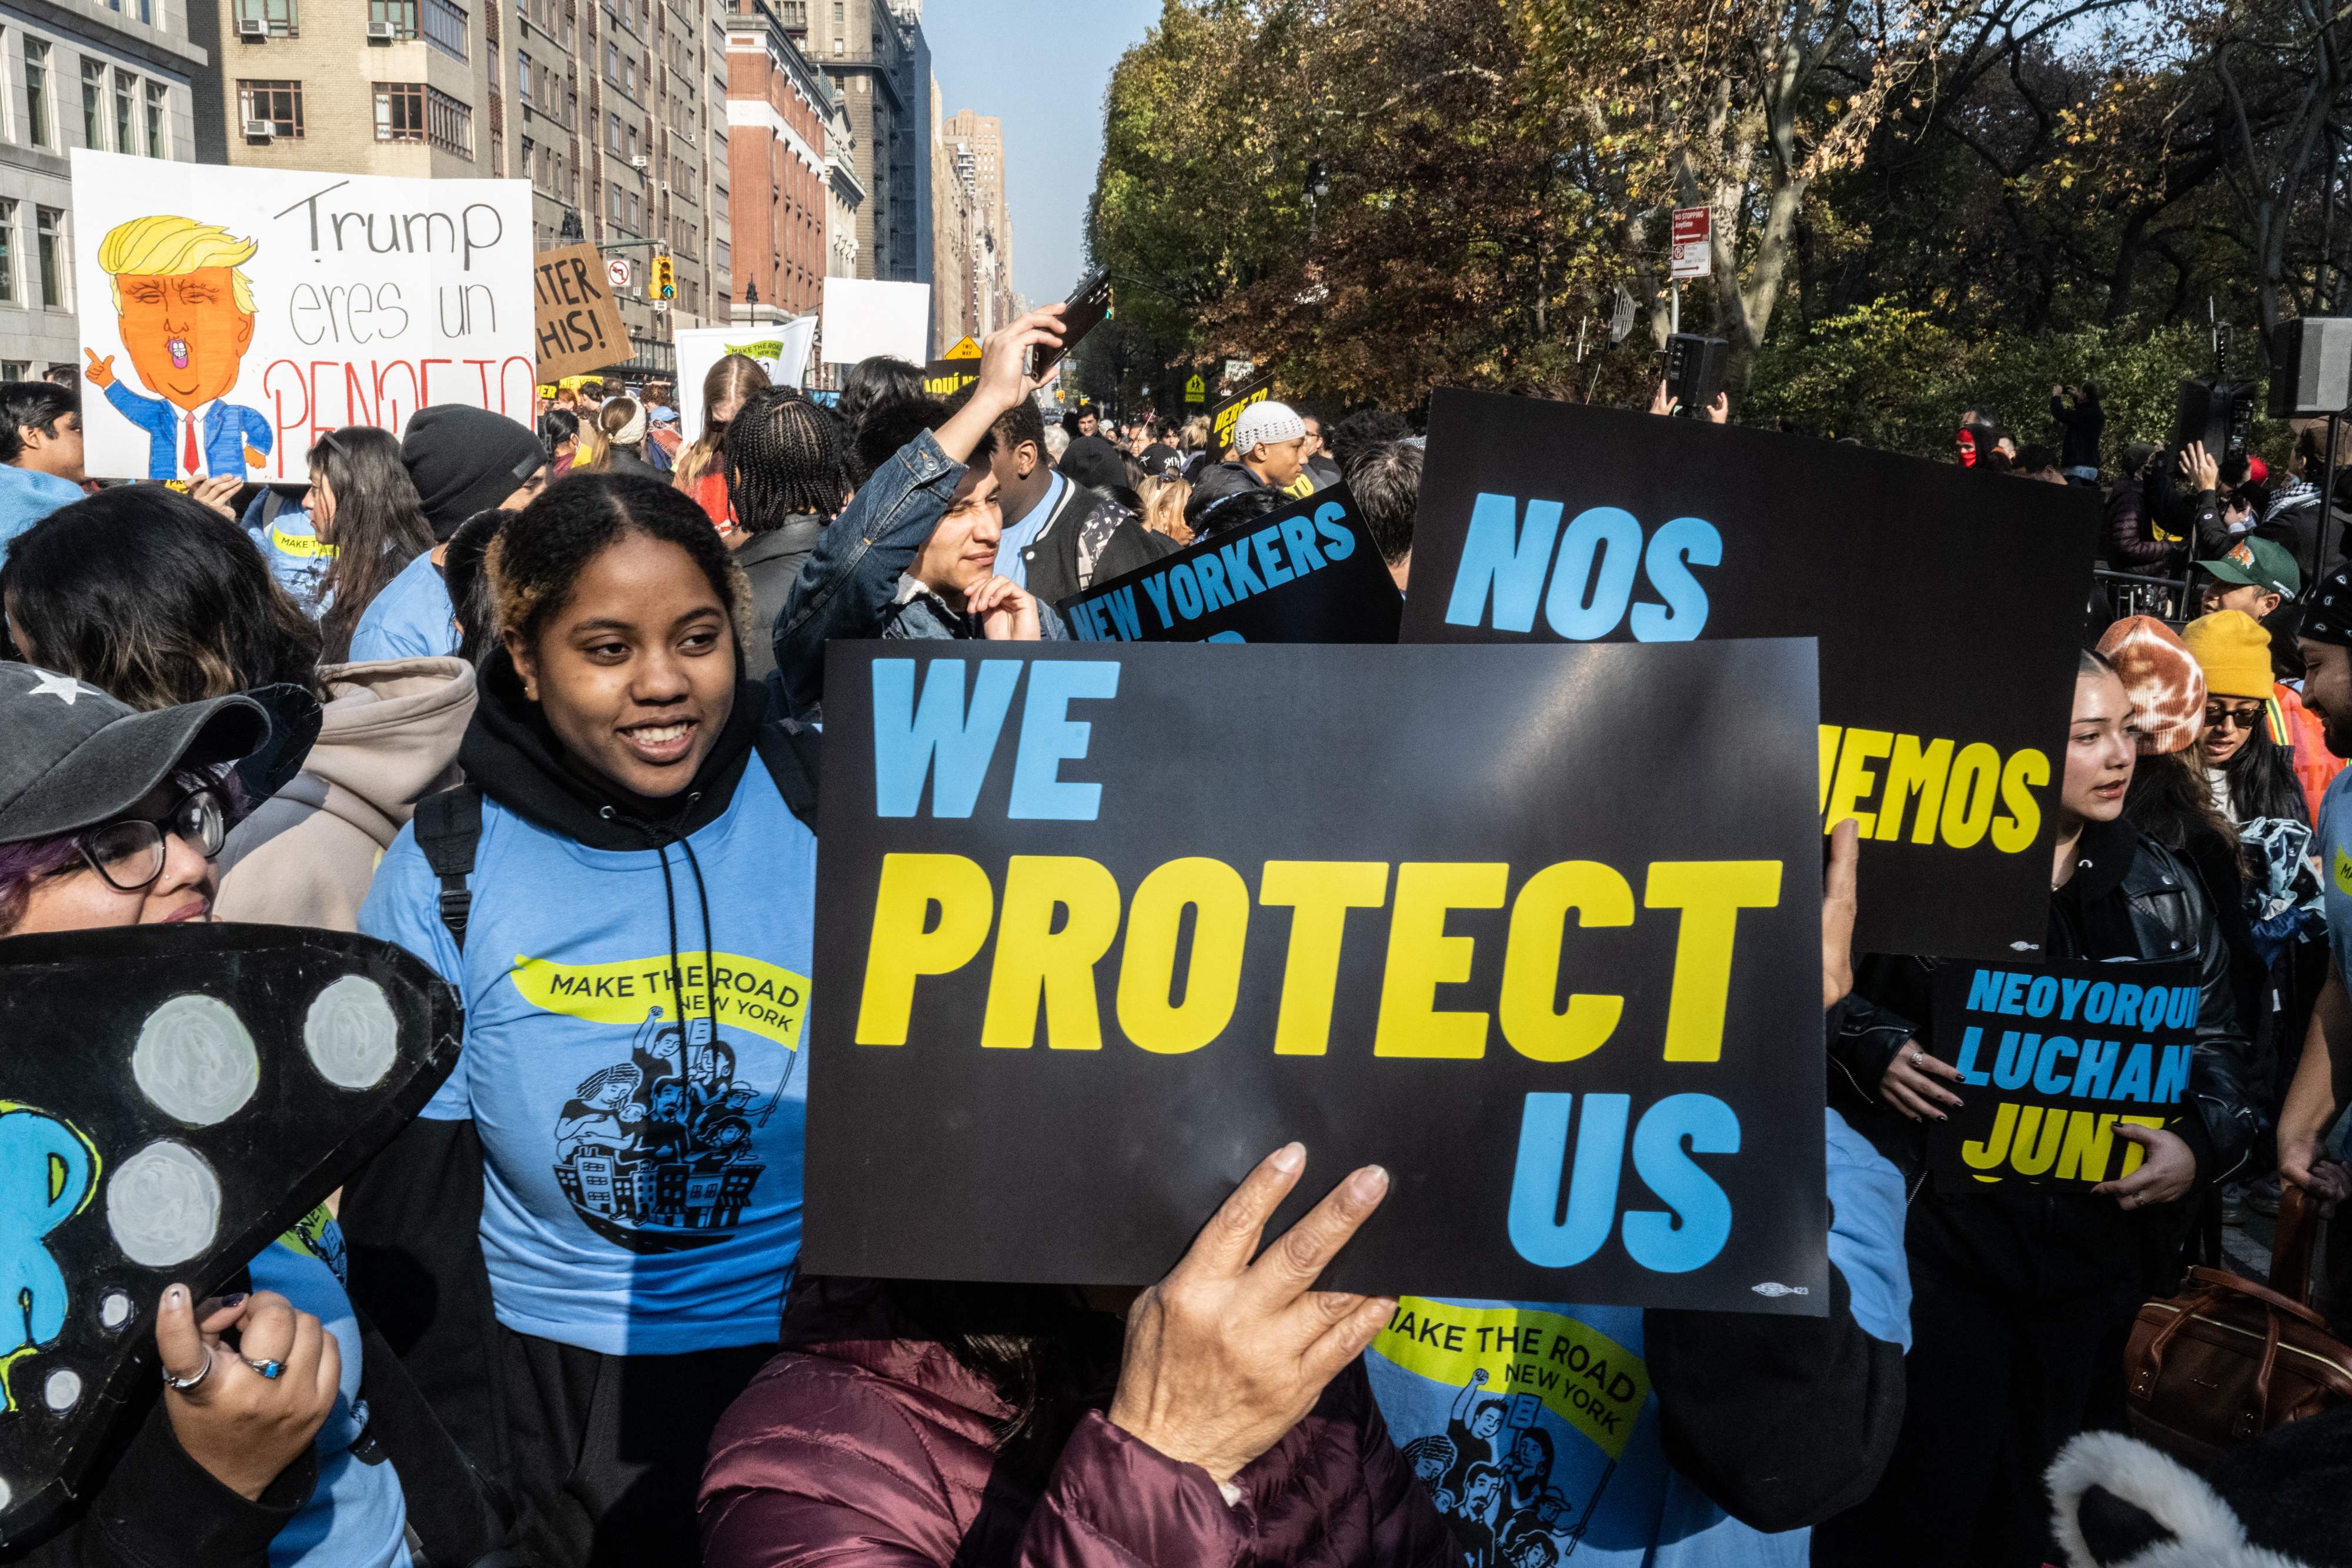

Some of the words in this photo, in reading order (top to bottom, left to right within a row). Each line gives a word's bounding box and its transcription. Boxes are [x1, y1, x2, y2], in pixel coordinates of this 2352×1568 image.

[273, 180, 503, 271] Trump
[1675, 221, 1693, 229] Anytime
[1682, 211, 1703, 219] STOPPING
[290, 283, 408, 345] eres
[440, 284, 496, 338] un
[534, 258, 602, 305] TTER
[768, 343, 782, 351] ROAD
[1214, 397, 1248, 434] HERE
[1251, 387, 1268, 402] TO
[281, 537, 308, 548] MAKE
[1069, 584, 1142, 642] NEW
[1141, 501, 1356, 629] YORKERS
[1445, 492, 1723, 643] NOS
[871, 658, 1121, 820] WE
[550, 974, 634, 998] MAKE
[643, 965, 704, 994] THE
[713, 967, 799, 1008] ROAD
[854, 852, 1783, 1062] PROTECT
[681, 995, 729, 1011] NEW
[737, 998, 794, 1032] YORK
[1962, 1102, 2181, 1182] JUNT
[1506, 1091, 1741, 1273] US
[1476, 1326, 1543, 1355] THE
[1549, 1335, 1636, 1403] ROAD
[1505, 1363, 1560, 1391] NEW
[1563, 1379, 1624, 1435] YORK
